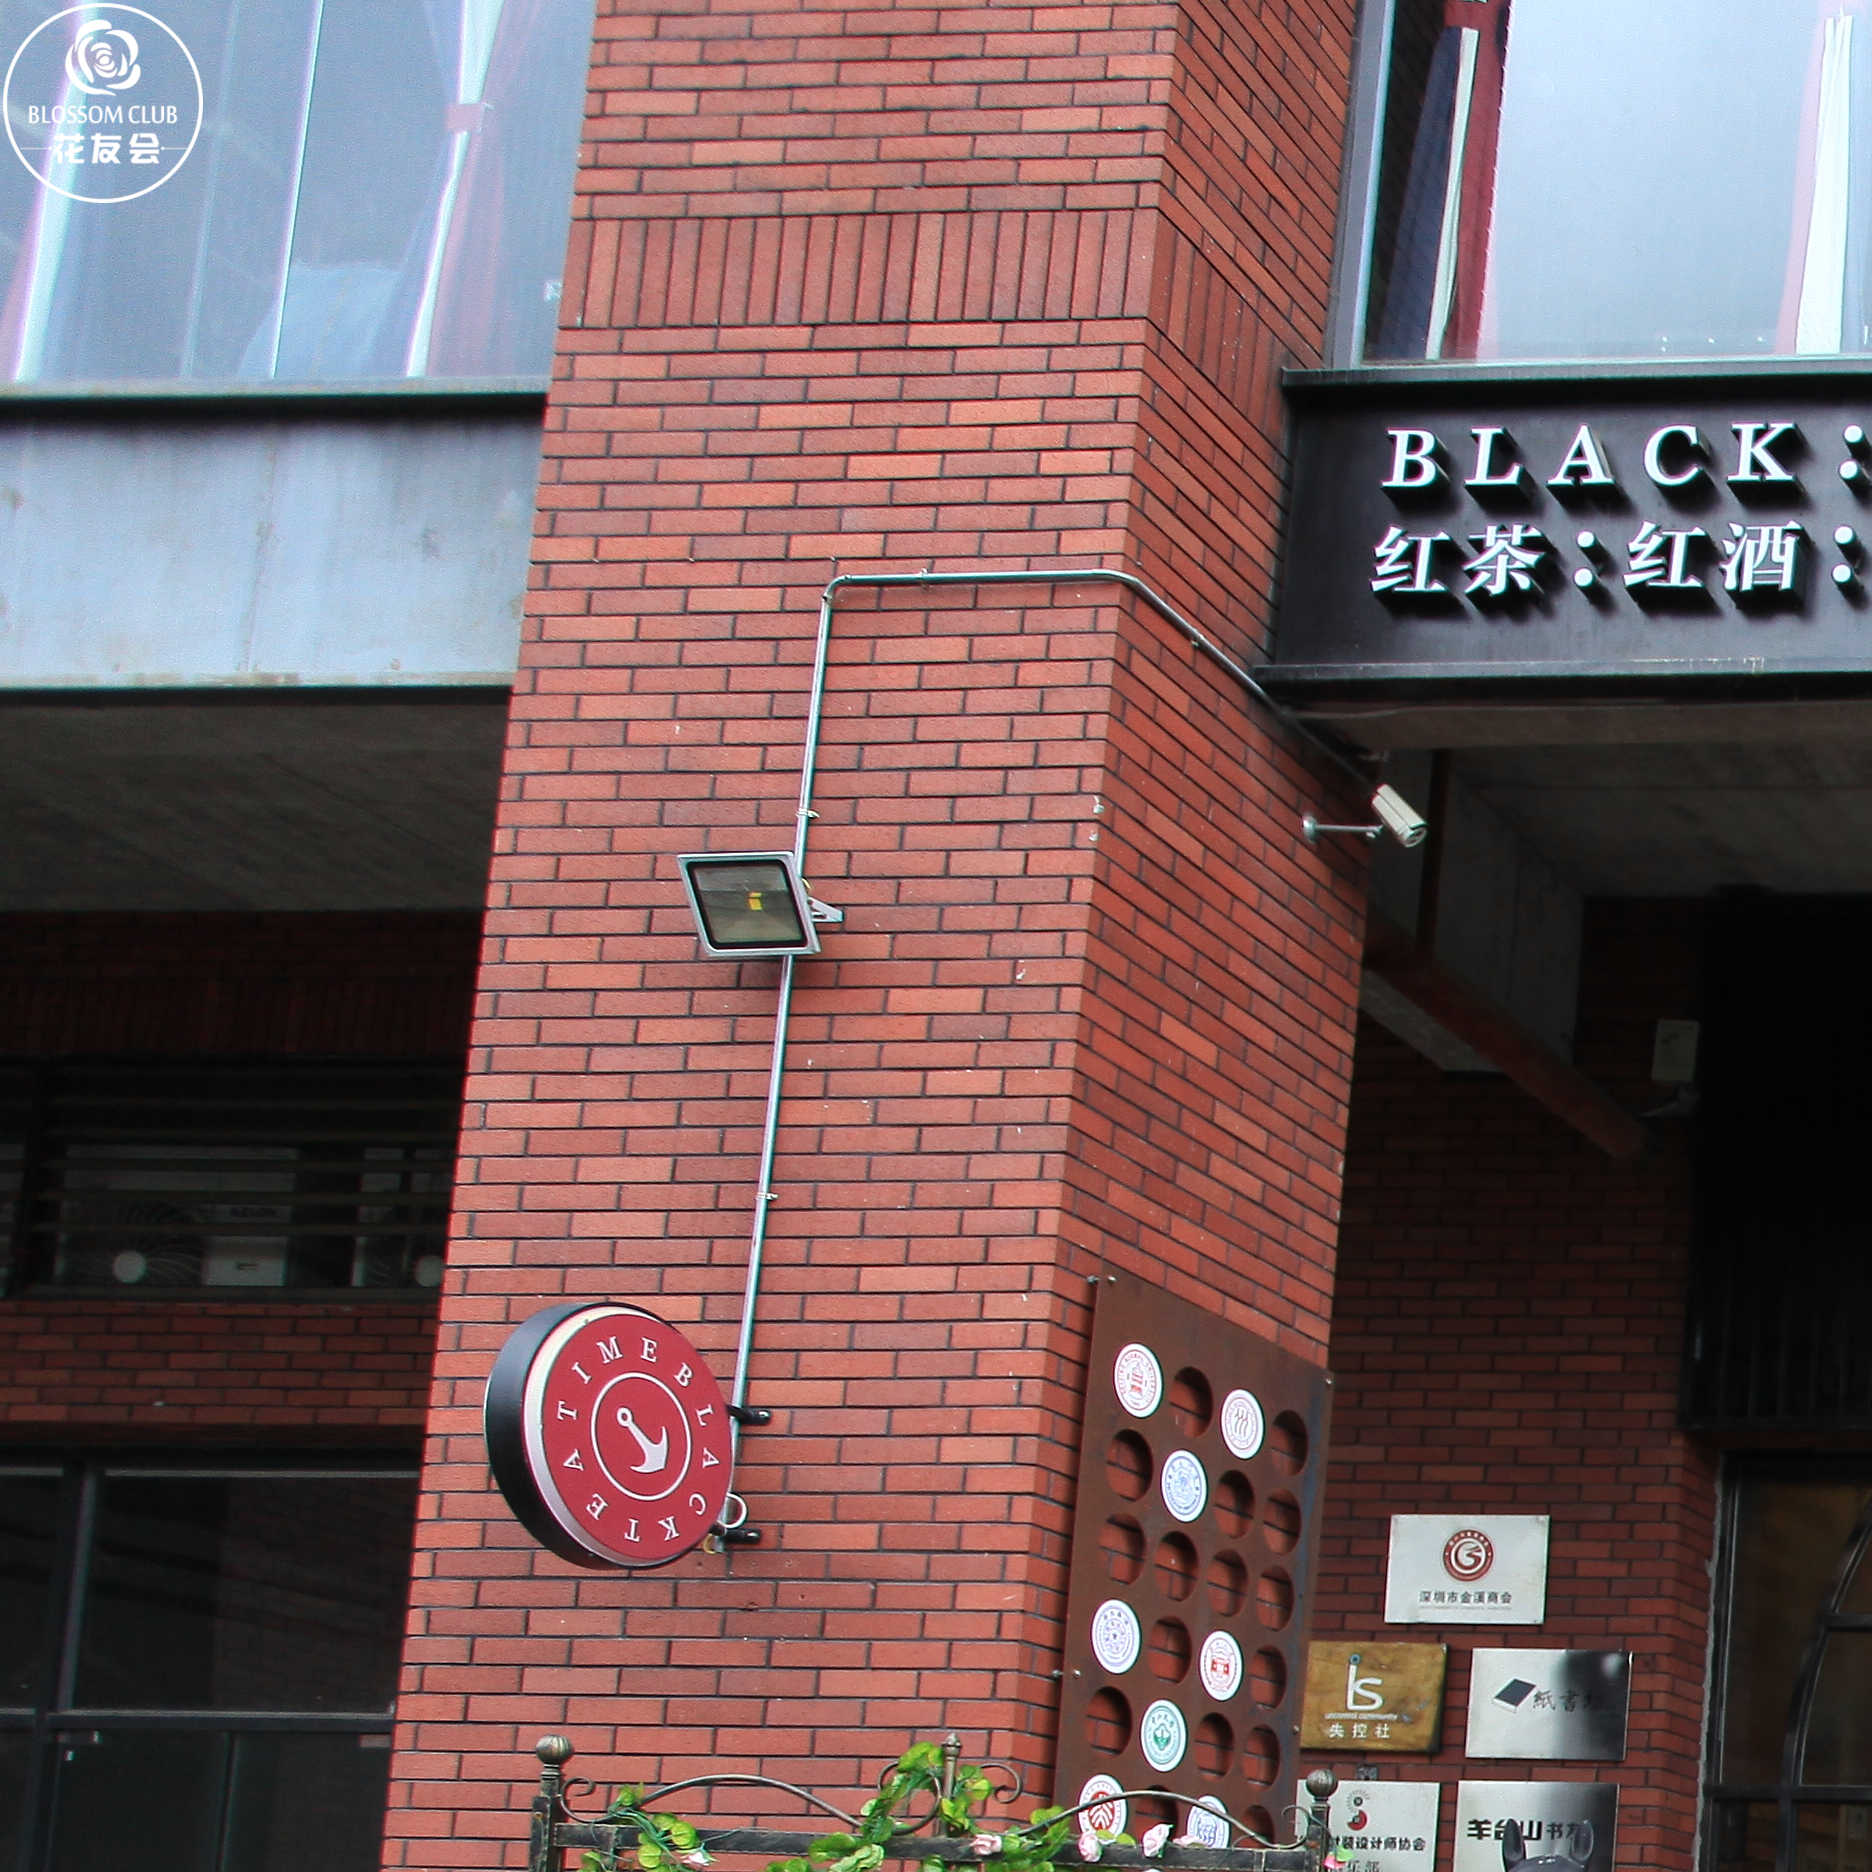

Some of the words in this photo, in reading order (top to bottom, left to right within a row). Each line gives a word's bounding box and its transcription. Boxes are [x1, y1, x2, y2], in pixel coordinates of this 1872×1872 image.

[1382, 421, 1799, 490] BLACK
[1328, 1723, 1391, 1739] 失控社
